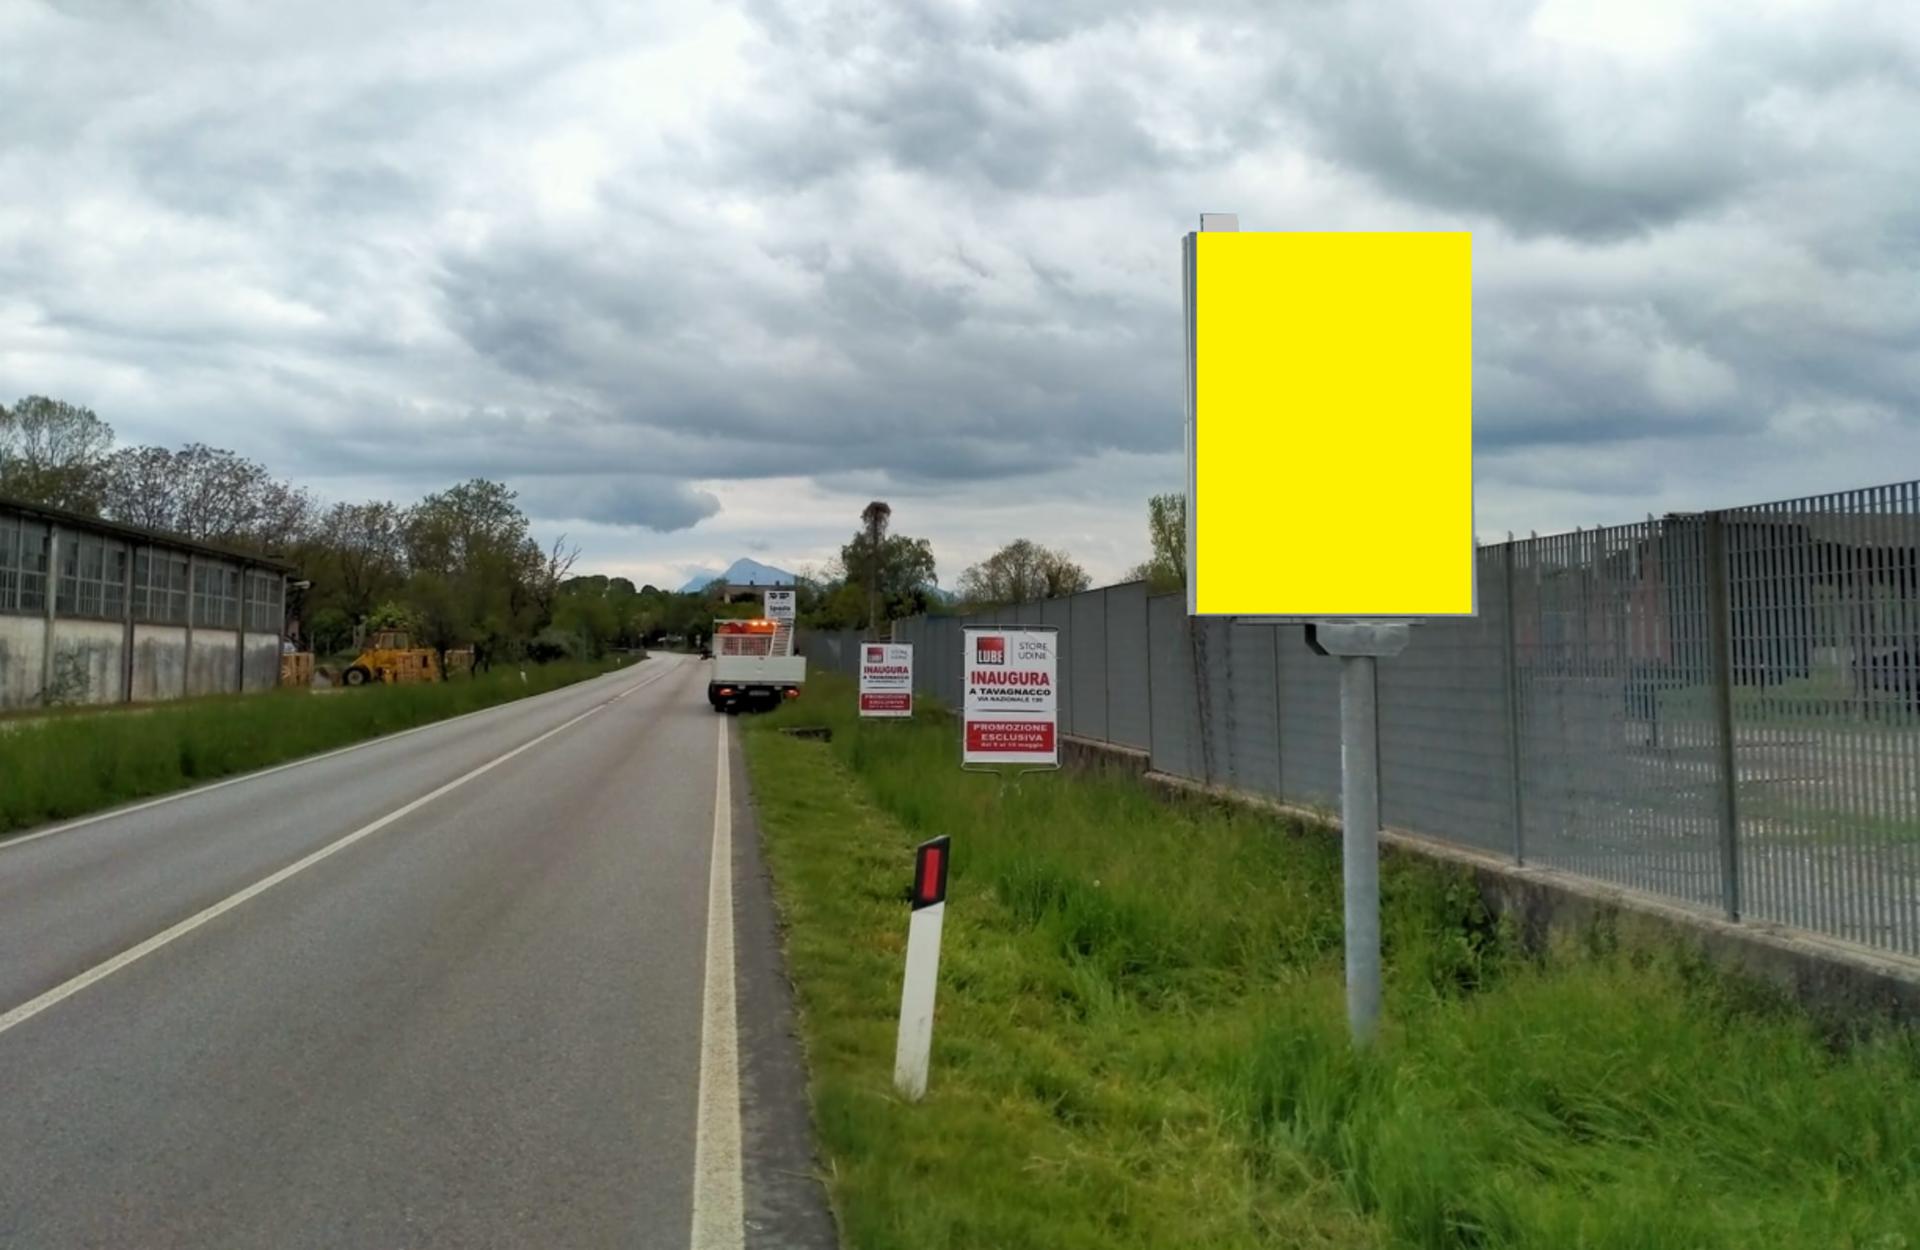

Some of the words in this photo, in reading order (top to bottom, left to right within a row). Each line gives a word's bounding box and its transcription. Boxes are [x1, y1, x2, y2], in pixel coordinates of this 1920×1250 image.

[1019, 642, 1048, 651] STORE
[978, 650, 1004, 663] LUBE
[971, 671, 1050, 686] INAUGURA
[980, 688, 1052, 696] TAVAGNACCO
[973, 724, 1048, 732] PROMOZIONE
